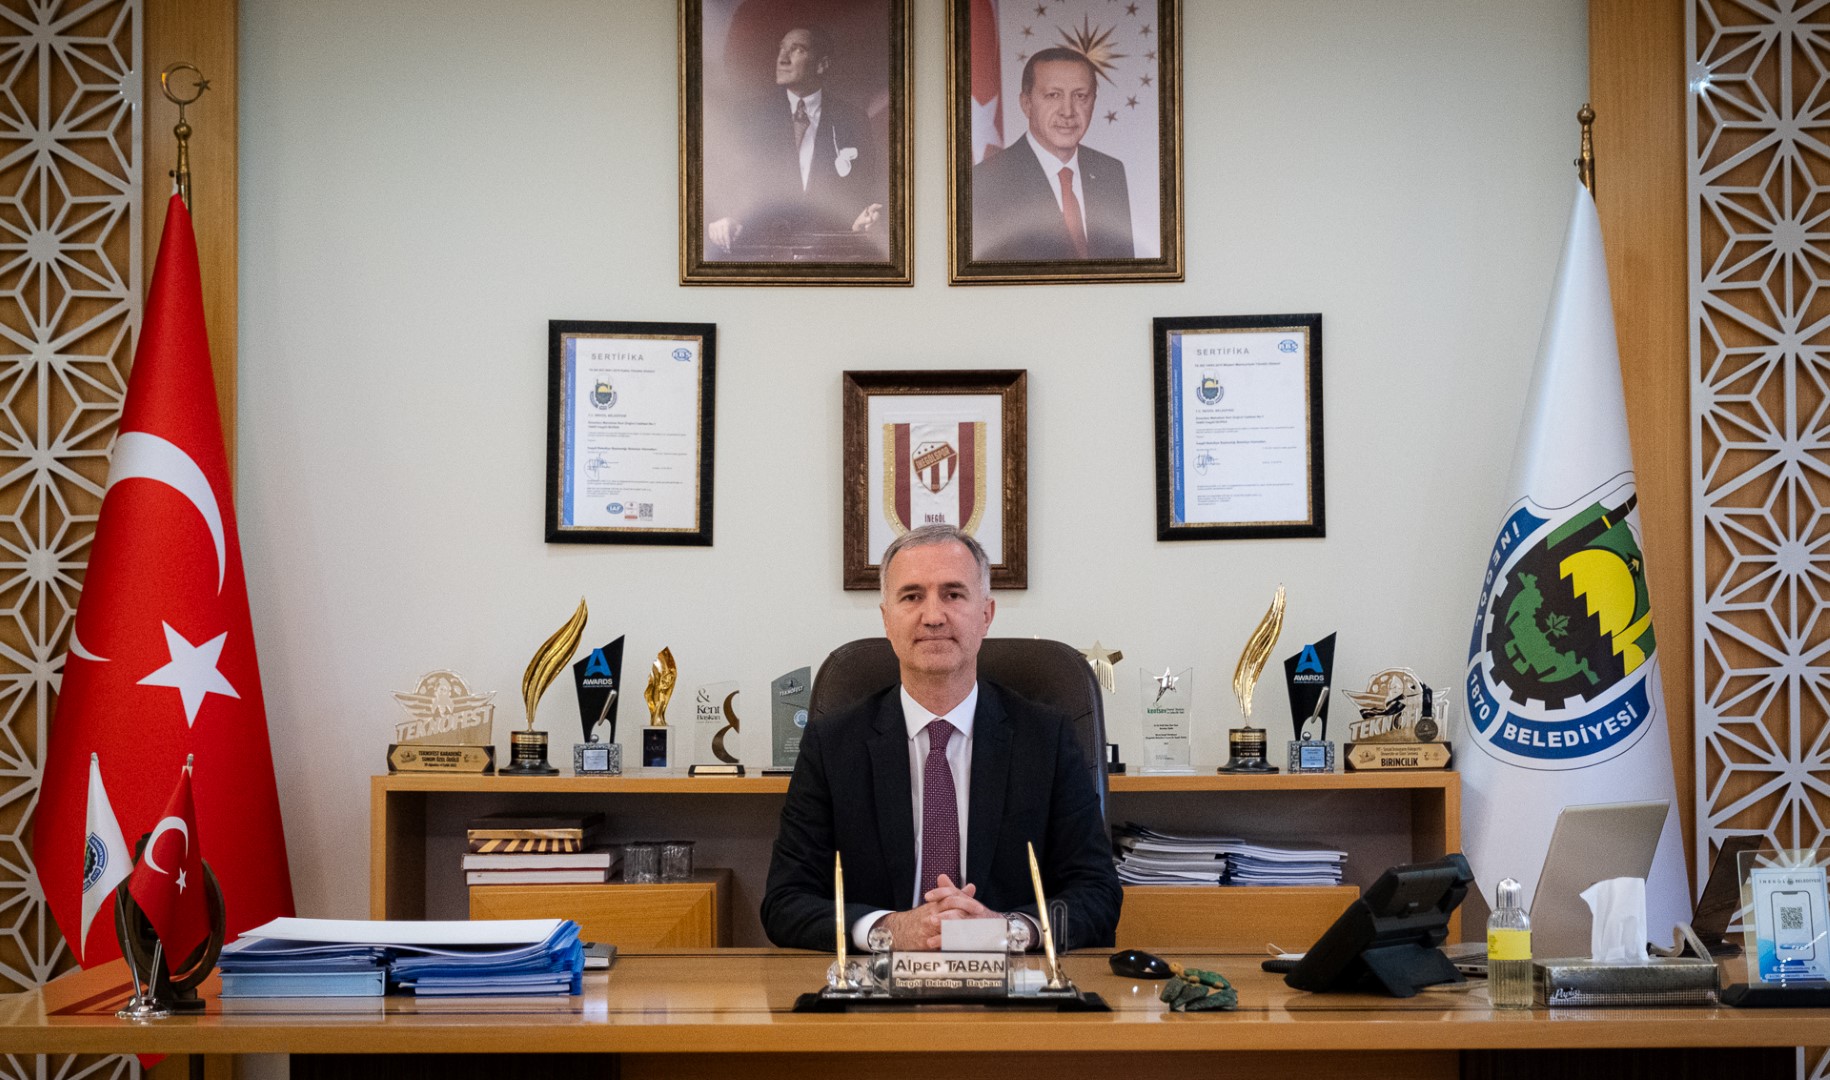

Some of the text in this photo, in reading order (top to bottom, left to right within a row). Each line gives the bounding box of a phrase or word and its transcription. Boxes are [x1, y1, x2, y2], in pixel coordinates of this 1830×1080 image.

[591, 352, 644, 361] SERTİFİKA
[1196, 347, 1250, 356] SERTİFİKA
[924, 513, 946, 523] İNEGÖL
[1475, 521, 1521, 627] İNEGÖL
[1470, 673, 1491, 720] 1870
[696, 705, 720, 714] Kent
[396, 705, 491, 742] TEKNOFEST
[1503, 701, 1638, 748] BELEDİYESİ
[1381, 757, 1418, 767] BİRİNCİLİK
[895, 959, 1005, 974] Alper TABAN
[896, 978, 1002, 989] İnegöl Belediye Başkanı
